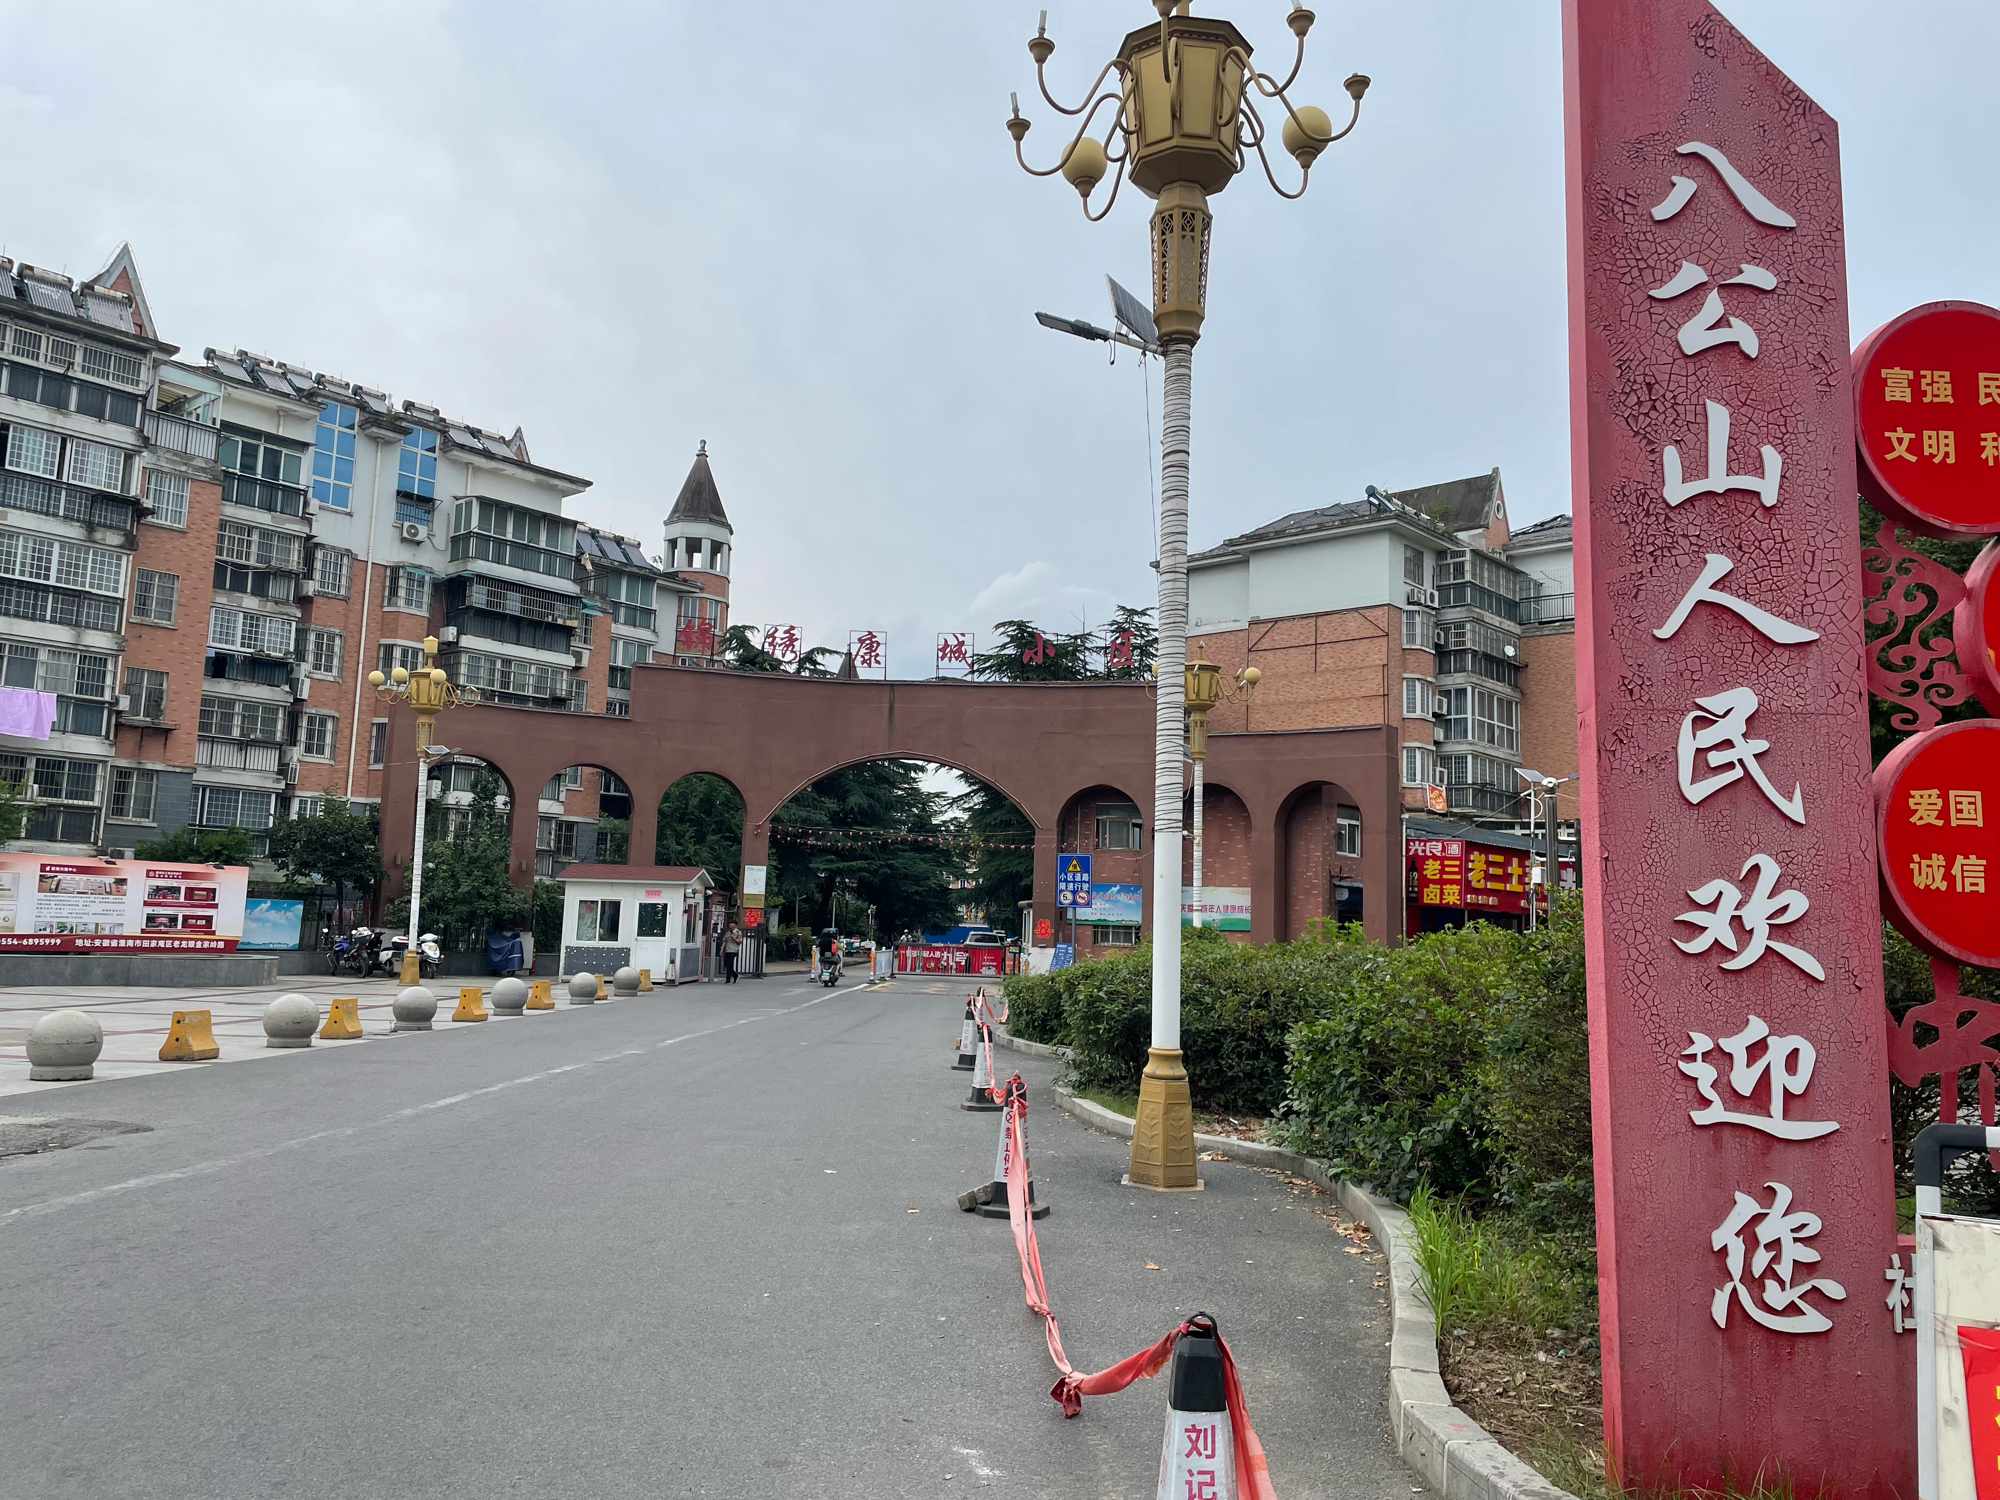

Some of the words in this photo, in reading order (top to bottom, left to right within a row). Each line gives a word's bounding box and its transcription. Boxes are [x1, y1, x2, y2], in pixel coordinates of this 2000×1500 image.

[1881, 367, 1954, 404] 富强
[1884, 427, 1956, 464] 文明
[678, 617, 1134, 670] 锦绣康城小区
[1648, 141, 1847, 1333] 八公山人民欢迎您
[1908, 788, 1984, 828] 爱国
[1059, 872, 1090, 882] 小区道路
[1059, 882, 1090, 891] 限速行驶
[1423, 859, 1461, 879] 老三
[1910, 853, 1987, 894] 诚信
[1181, 904, 1251, 914] 关爱成年人健康成长
[1423, 884, 1461, 905] 卤菜
[0, 937, 61, 946] 554-6895999
[1184, 1424, 1217, 1500] 刘记
